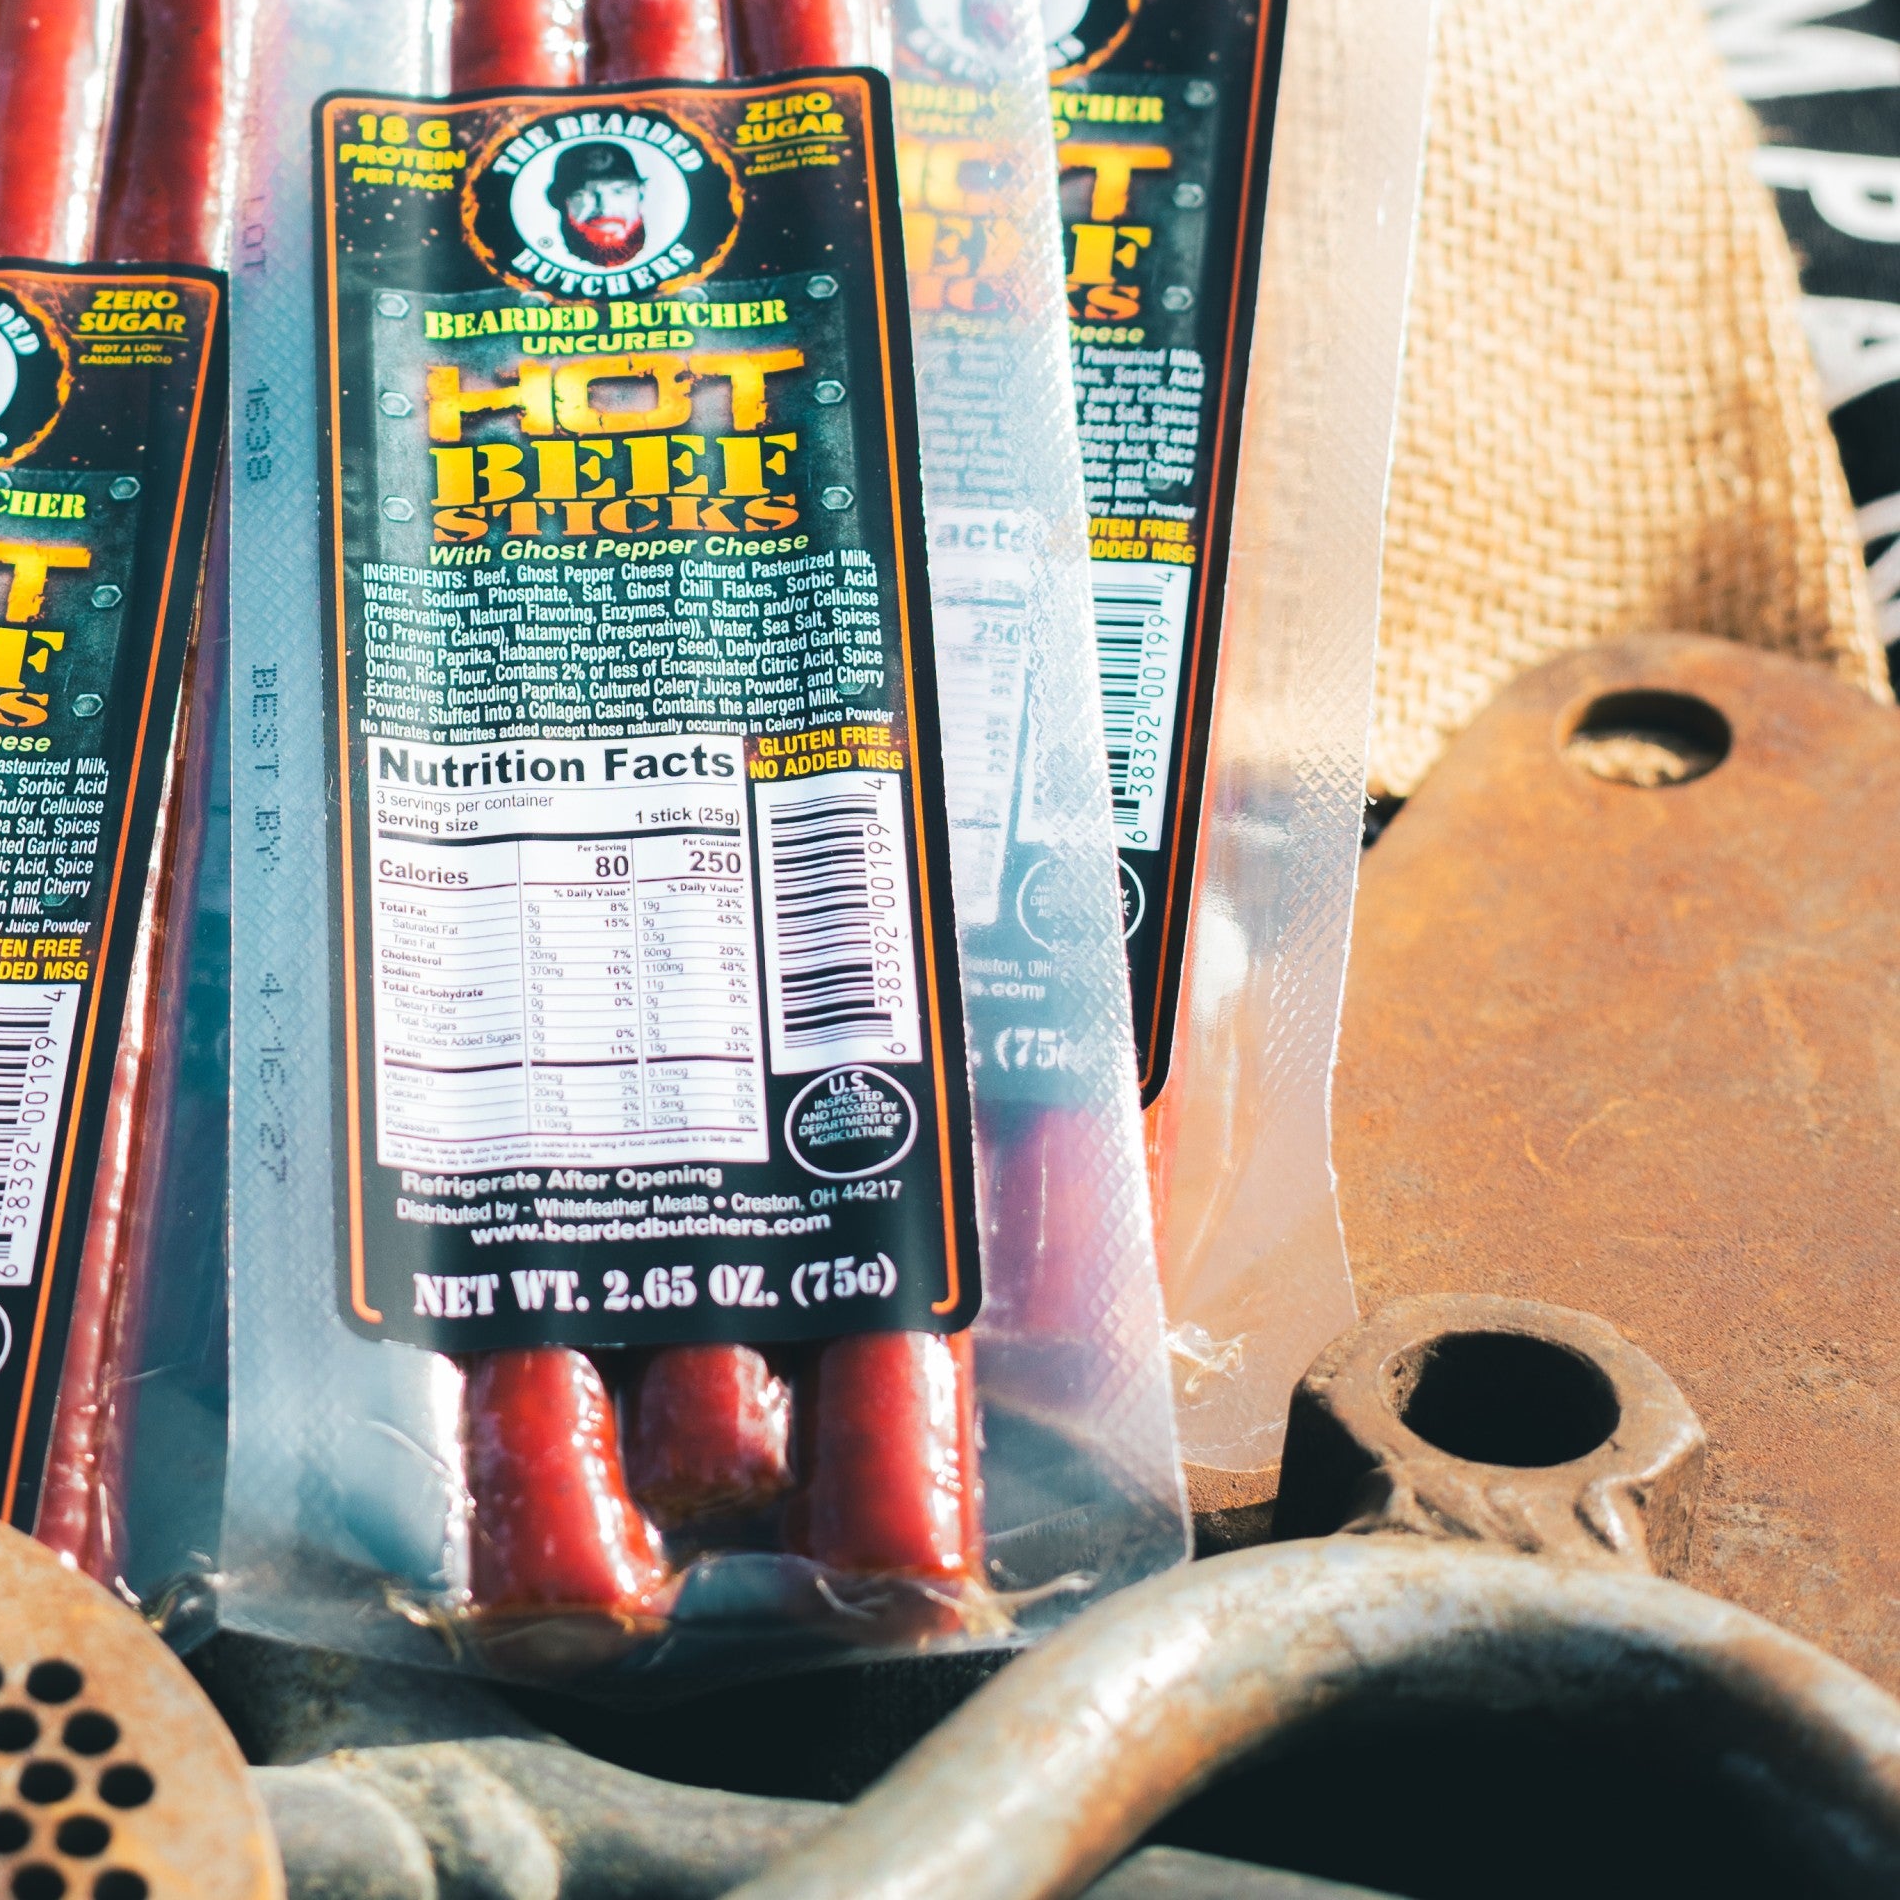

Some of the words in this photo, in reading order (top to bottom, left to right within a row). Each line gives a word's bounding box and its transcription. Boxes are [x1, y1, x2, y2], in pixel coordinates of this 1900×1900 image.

[745, 92, 833, 122] ZERO
[359, 115, 411, 142] 18
[417, 118, 451, 146] G
[736, 112, 844, 145] SUGAR
[340, 143, 466, 170] PROTEIN
[491, 121, 553, 176] THE
[556, 113, 704, 176] BEARDED
[352, 168, 393, 186] PER
[397, 169, 454, 190] PACK
[511, 241, 697, 297] BUTCHERS
[92, 290, 179, 310] ZERO
[78, 311, 187, 334] SUGAR
[425, 307, 599, 340] BEARDED
[609, 299, 789, 330] BUTCHER
[522, 330, 694, 355] UNCURED
[426, 348, 805, 442] HOT
[429, 433, 798, 508] BEEF
[433, 494, 800, 542] STICKS
[1140, 519, 1189, 543] FREE
[429, 545, 491, 565] With
[501, 539, 587, 560] Ghost
[594, 537, 698, 561] Pepper
[705, 535, 809, 556] Cheese
[1152, 541, 1196, 565] MSG
[363, 563, 467, 588] INGREDIENTS:
[474, 568, 511, 587] Beef,
[517, 565, 558, 583] Ghost
[565, 565, 615, 585] Pepper
[621, 562, 674, 579] Cheese
[680, 559, 745, 580] (Cultured
[752, 551, 835, 578] Pasteurized
[841, 550, 876, 569] Milk,
[364, 583, 414, 606] Water,
[422, 590, 479, 608] Sodium
[489, 585, 572, 605] Phosphate,
[582, 585, 617, 602] Salt,
[626, 581, 670, 600] Ghost
[680, 580, 713, 597] Chili
[723, 581, 777, 599] Flakes,
[786, 572, 835, 593] Sorbic
[844, 569, 877, 587] Acid
[253, 662, 280, 779] BEST
[759, 729, 835, 756] GLUTEN
[841, 728, 891, 746] FREE
[378, 746, 585, 787] Nutrition
[604, 744, 735, 781] Facts
[750, 760, 779, 778] NO
[784, 752, 852, 776] ADDED
[858, 749, 903, 770] MSG
[391, 793, 451, 815] servings
[457, 800, 481, 814] per
[485, 793, 553, 810] container
[378, 810, 439, 832] Serving
[446, 818, 479, 832] size
[651, 807, 692, 822] stick
[698, 807, 740, 825] (25g)
[379, 859, 468, 884] Calories
[595, 855, 629, 877] 80
[690, 851, 741, 873] 250
[32, 938, 83, 957] FREE
[43, 961, 89, 981] MSG
[829, 1072, 871, 1095] U.S.
[814, 1091, 883, 1110] INSPECTED
[799, 1116, 880, 1136] DEPARTMENT
[883, 1113, 902, 1124] OF
[809, 1126, 894, 1147] AGRICULTURE
[401, 1171, 540, 1199] Refrigerate
[548, 1170, 610, 1191] After
[616, 1165, 722, 1192] Opening
[397, 1197, 491, 1223] Distributed
[496, 1204, 518, 1223] by
[535, 1196, 648, 1220] Whitefeather
[653, 1193, 709, 1215] Meats
[810, 1189, 837, 1206] OH
[842, 1180, 902, 1201] 44217
[471, 1211, 831, 1245] www.beardedbutchers.com
[413, 1272, 499, 1317] NET
[511, 1270, 590, 1311] WT.
[603, 1266, 698, 1311] 2.65
[708, 1264, 778, 1307] OZ.
